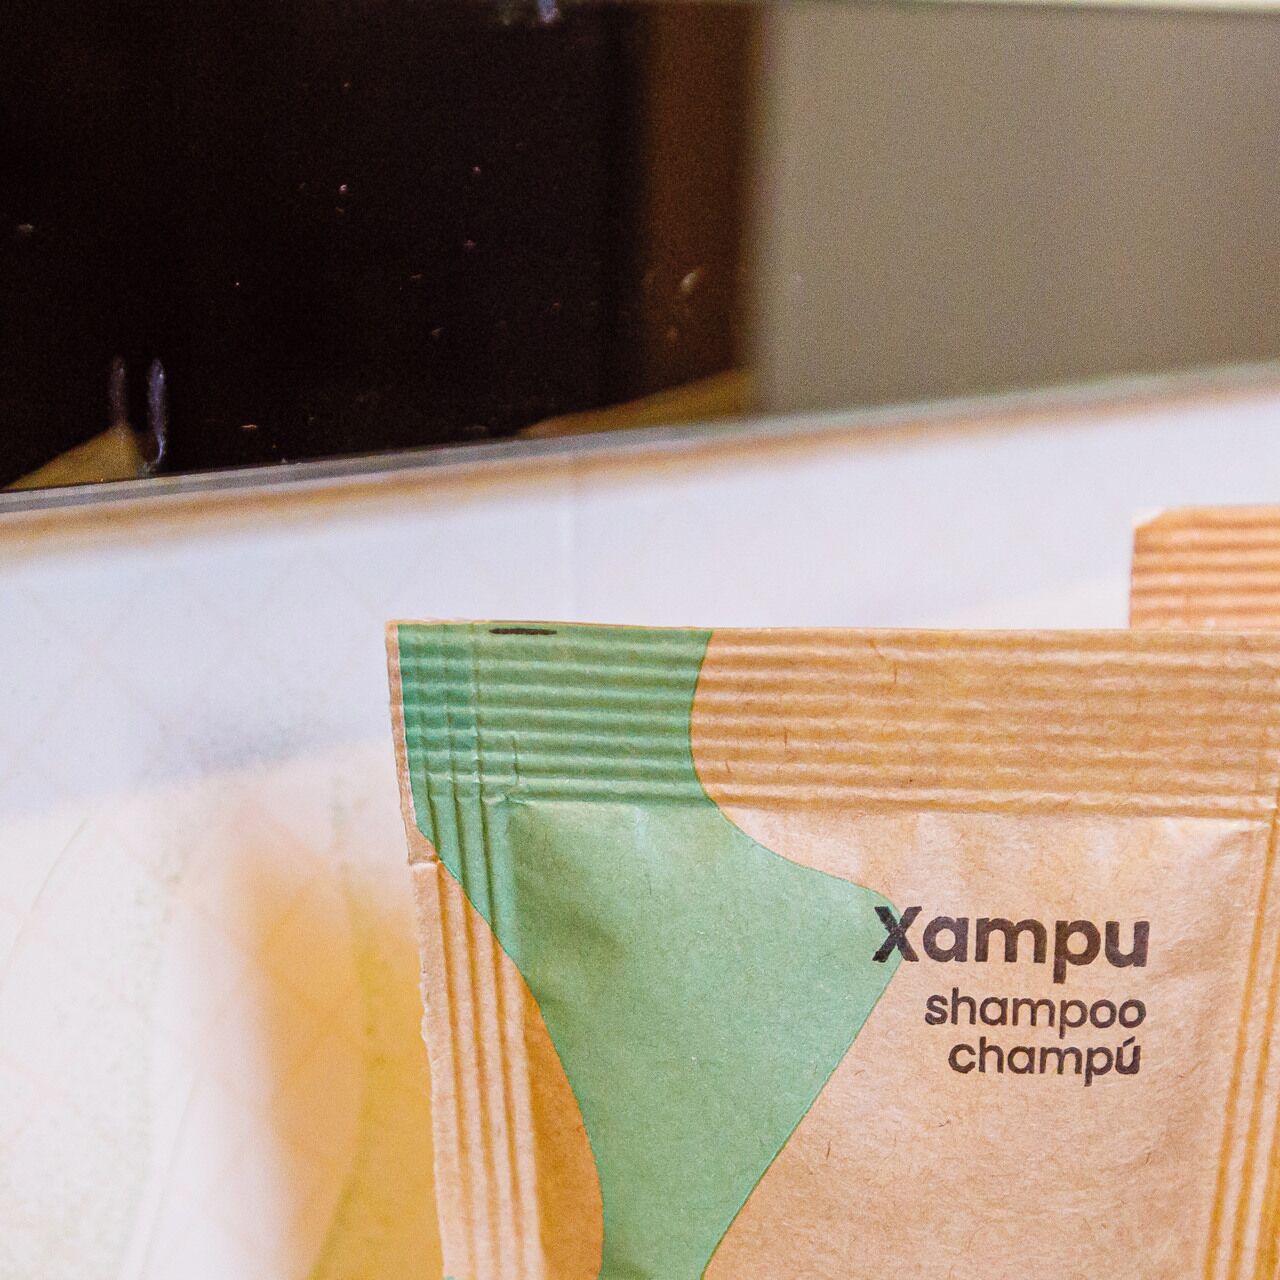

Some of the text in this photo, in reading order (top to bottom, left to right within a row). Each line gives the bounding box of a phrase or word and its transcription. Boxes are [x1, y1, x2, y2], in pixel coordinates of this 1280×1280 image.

[872, 905, 1150, 984] Xampu
[925, 987, 1147, 1040] shampoo
[948, 1036, 1141, 1087] champú
